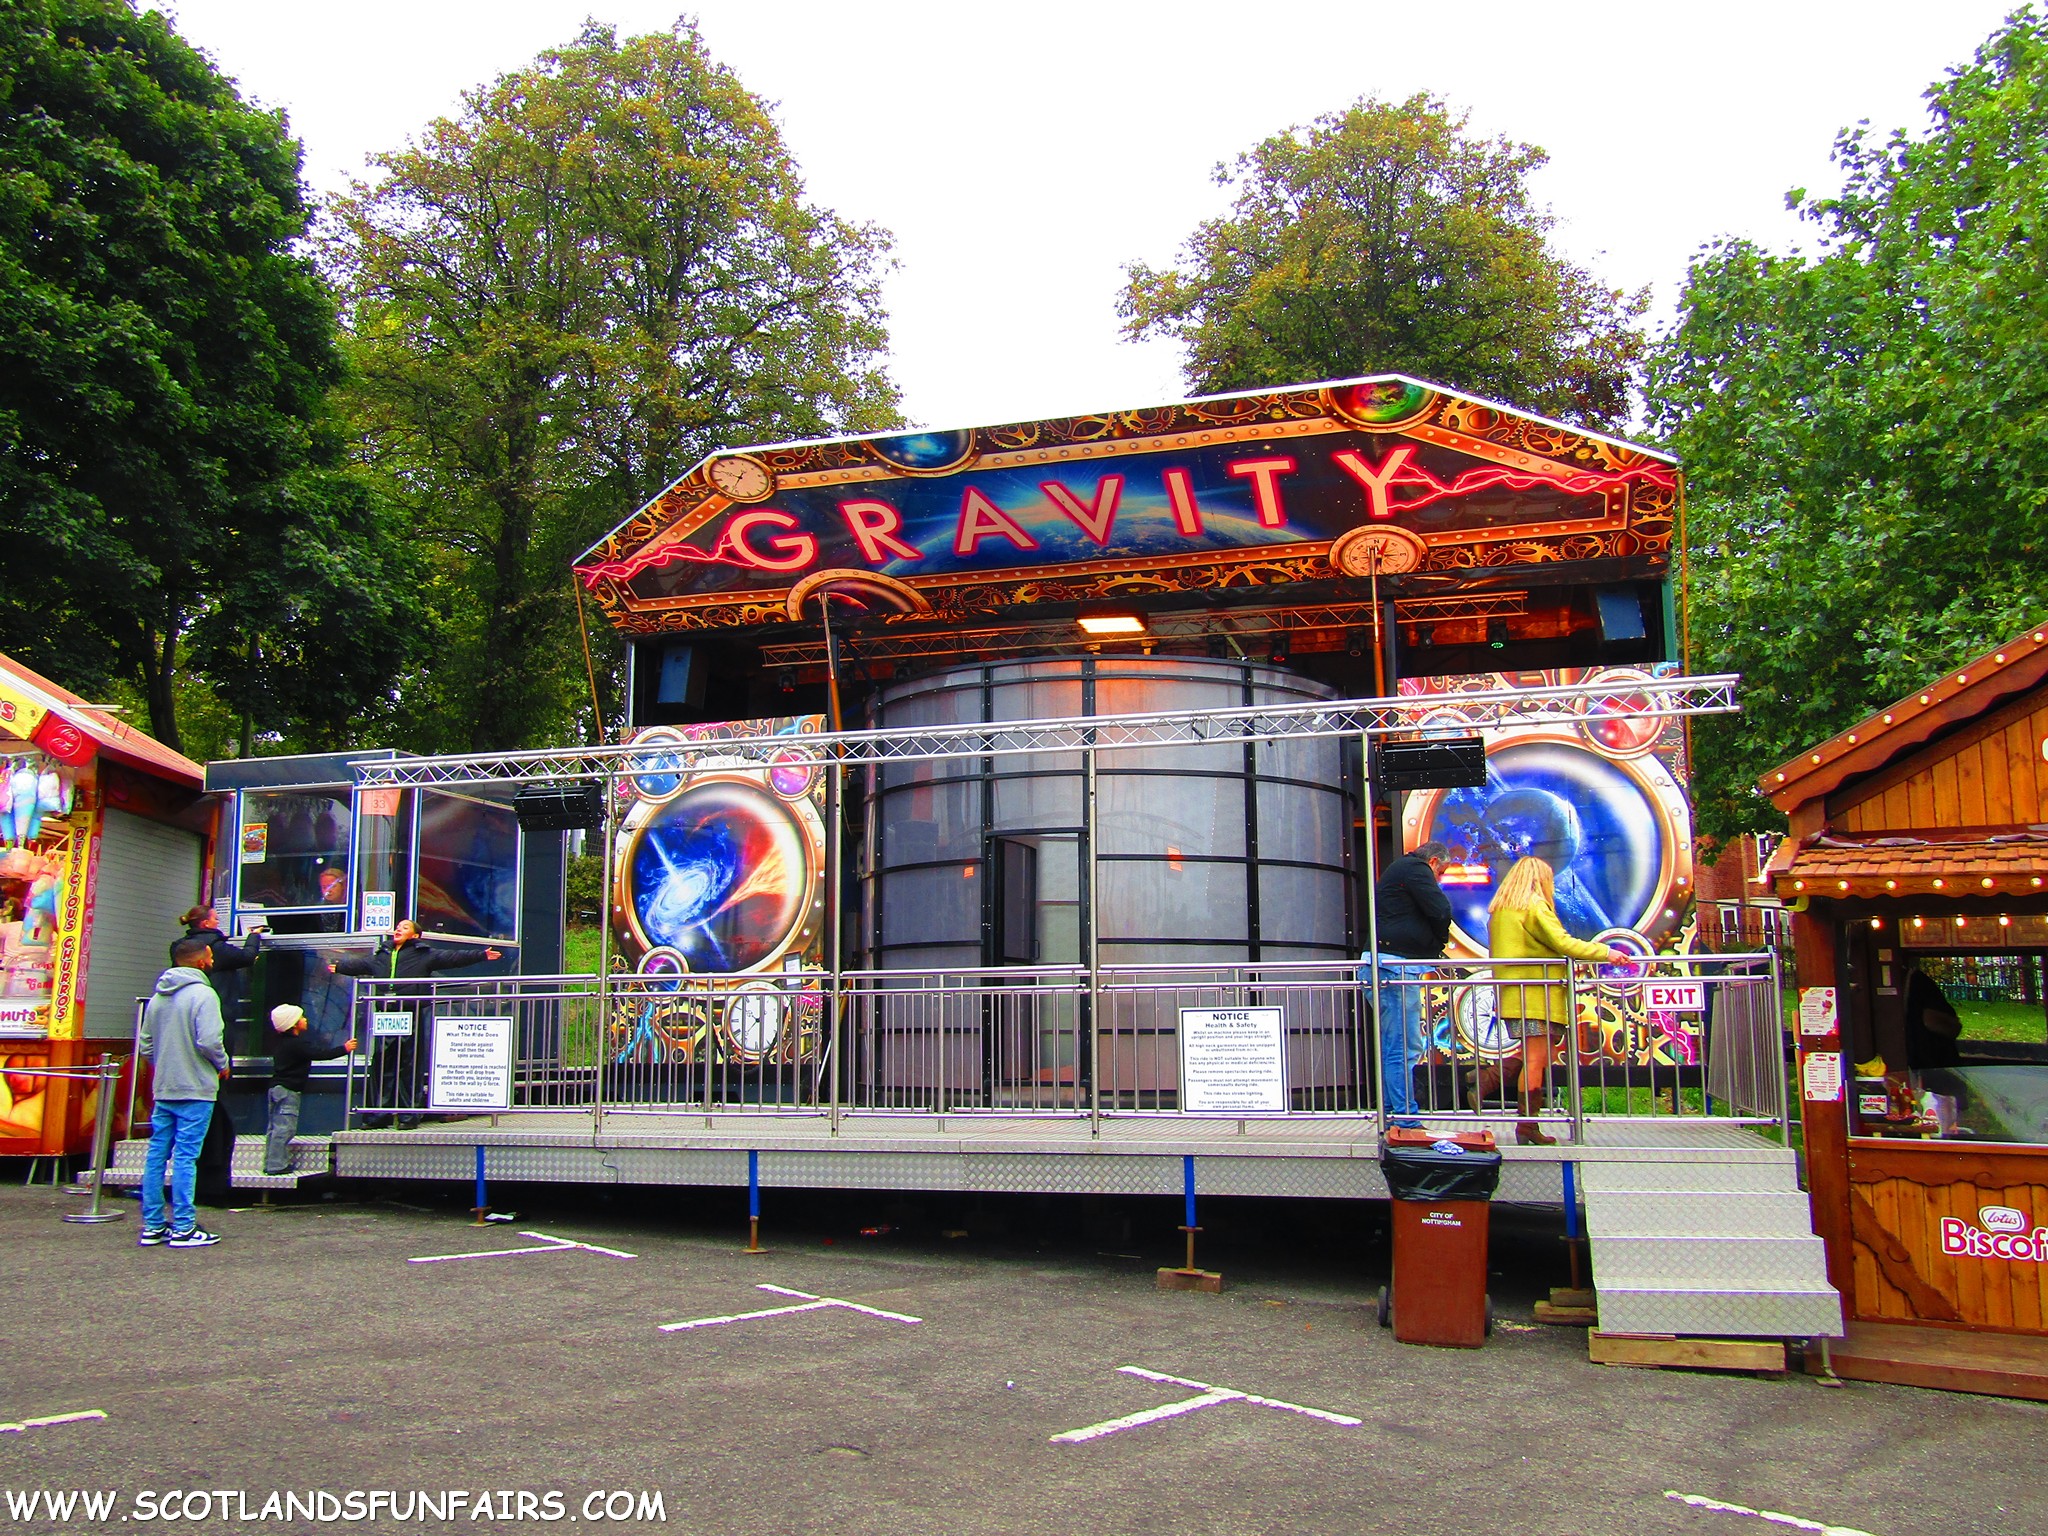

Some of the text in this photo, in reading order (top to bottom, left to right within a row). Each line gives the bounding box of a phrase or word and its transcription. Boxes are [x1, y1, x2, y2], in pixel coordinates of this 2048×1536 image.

[726, 446, 1414, 572] GRAVITY
[373, 799, 386, 809] 33
[55, 826, 88, 1019] DELICIOUS CHURROS
[1652, 988, 1696, 1005] EXIT
[377, 1018, 408, 1030] ENTRANCE
[1421, 1218, 1461, 1226] NOTTINGHAM
[1942, 1218, 2048, 1260] Biscof
